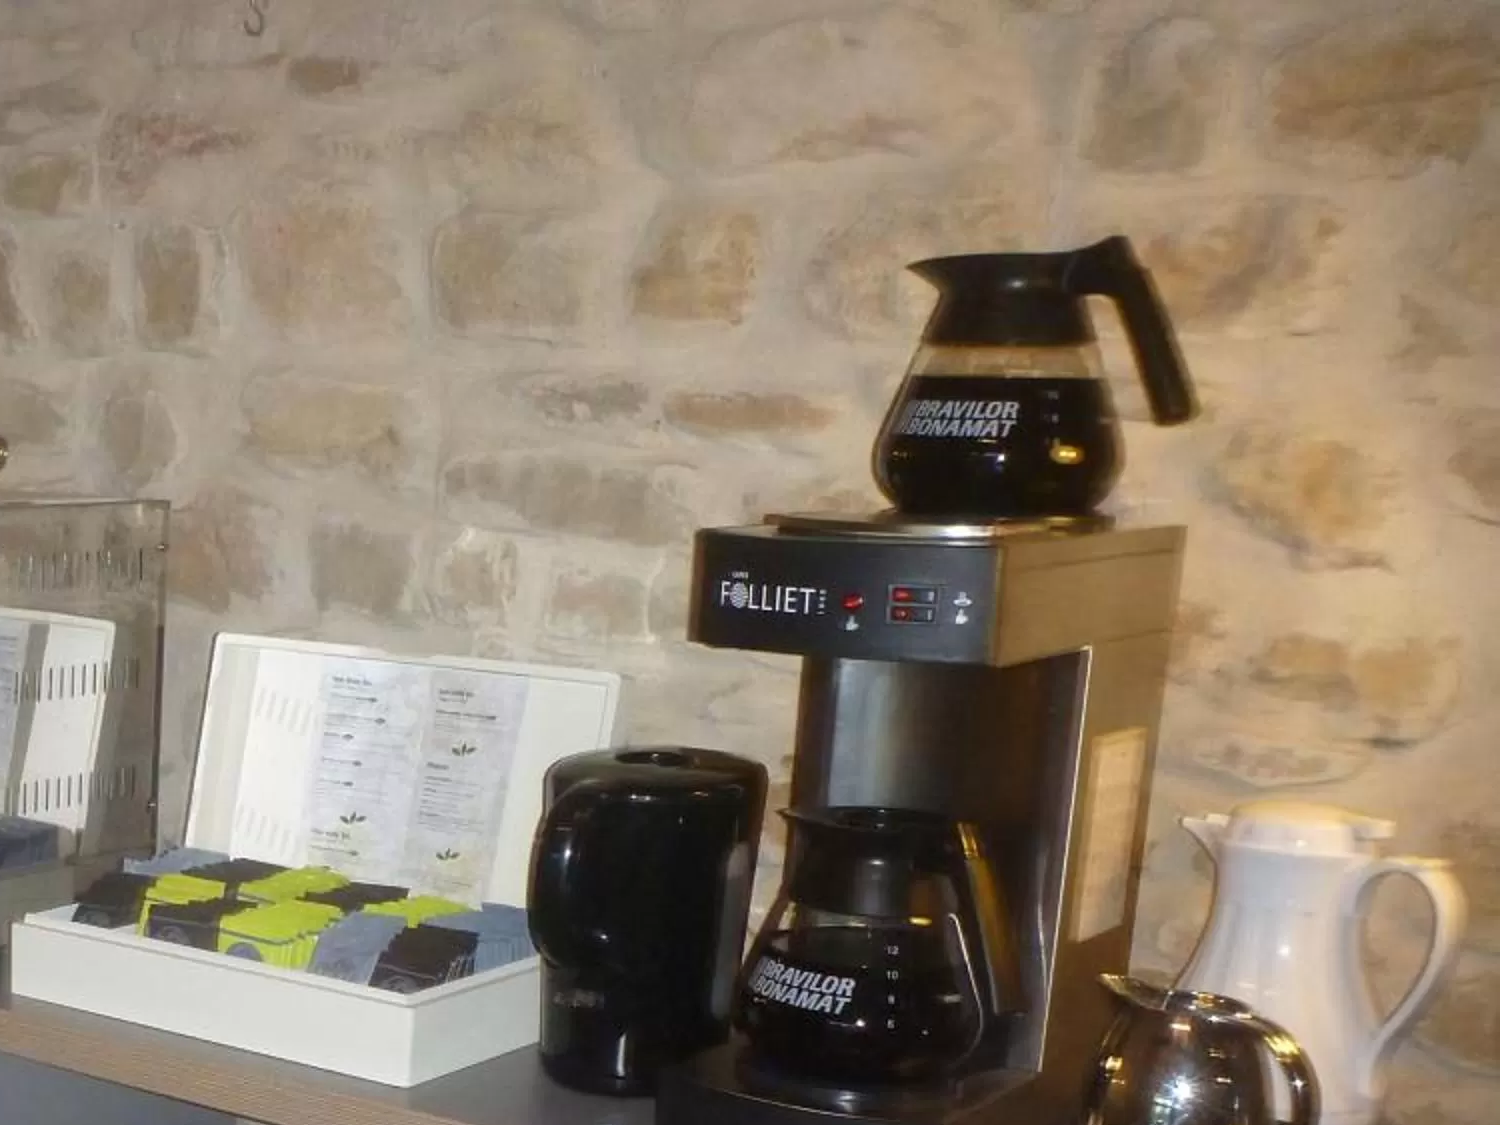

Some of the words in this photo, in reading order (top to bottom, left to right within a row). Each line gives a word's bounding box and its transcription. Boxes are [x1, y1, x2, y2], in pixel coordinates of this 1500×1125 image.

[915, 399, 1020, 419] BRAVILOR
[907, 417, 1017, 437] BONAMAT
[719, 579, 817, 615] FOLLIET
[762, 958, 856, 997] BRAVILOR
[886, 970, 900, 981] 10
[753, 974, 852, 1016] BONAMAT
